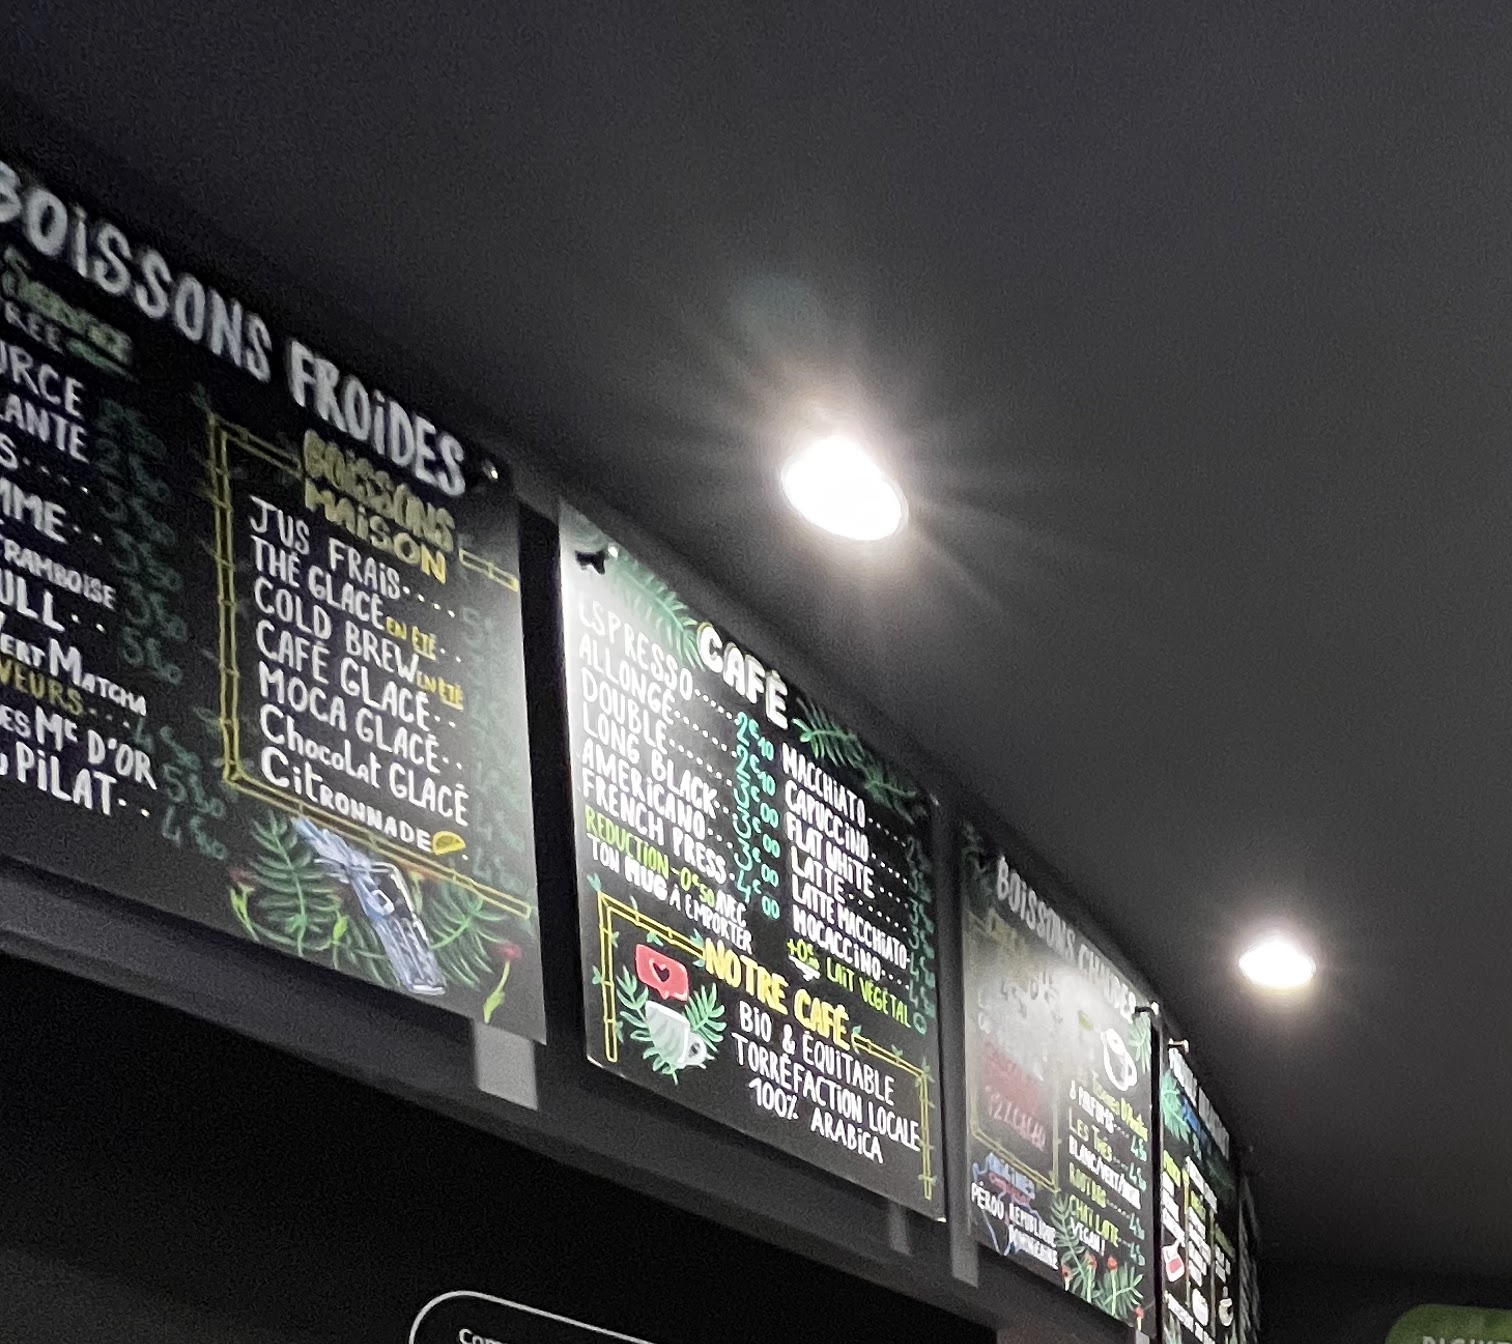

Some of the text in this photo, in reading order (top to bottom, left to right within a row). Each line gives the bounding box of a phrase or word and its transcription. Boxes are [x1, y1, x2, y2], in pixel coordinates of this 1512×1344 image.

[249, 495, 310, 555] JUS
[254, 576, 333, 640] COLD
[344, 620, 420, 683] BREW
[255, 619, 330, 685] CAFÉ
[340, 657, 430, 734] GLACÉ
[696, 621, 788, 730] CAFÉ
[258, 660, 441, 775] MOCA GLACÉ
[581, 667, 668, 755] DOUBLE
[86, 728, 158, 791] D'OR
[581, 700, 641, 765] LONG
[650, 752, 718, 820] BLACK
[389, 763, 469, 828] GLACÉ
[581, 767, 665, 846] FRENCH
[672, 826, 728, 884] PRESS
[785, 810, 823, 862] FLAT
[586, 832, 621, 875] TON
[624, 854, 668, 902] MUG
[684, 894, 753, 956] EMPORTER
[790, 846, 845, 904] LATTE
[792, 876, 836, 926] LATTE
[715, 889, 748, 928] AVEC
[703, 936, 851, 1051] NOTRE CAFÉ
[781, 1023, 797, 1056] &
[748, 1077, 799, 1121] 100%
[868, 1100, 922, 1153] LOCALE
